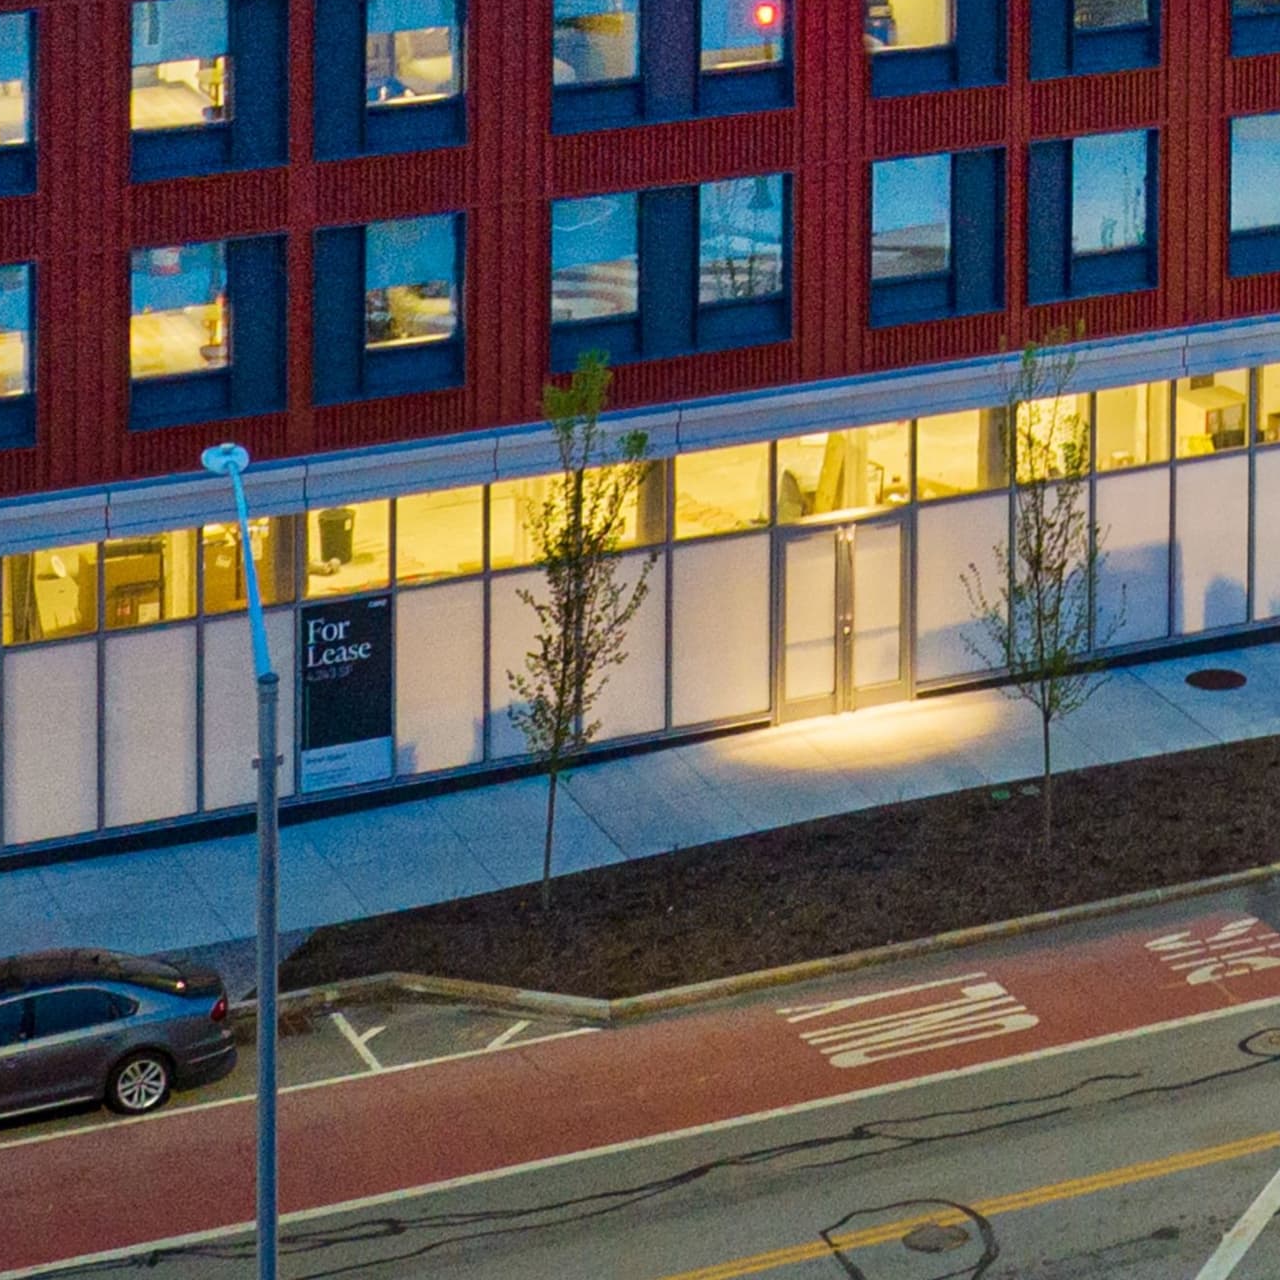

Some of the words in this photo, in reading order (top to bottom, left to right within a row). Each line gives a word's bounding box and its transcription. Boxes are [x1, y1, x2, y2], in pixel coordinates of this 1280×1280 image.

[307, 618, 351, 644] For
[307, 642, 372, 668] Lease
[775, 972, 1040, 1069] ONLY
